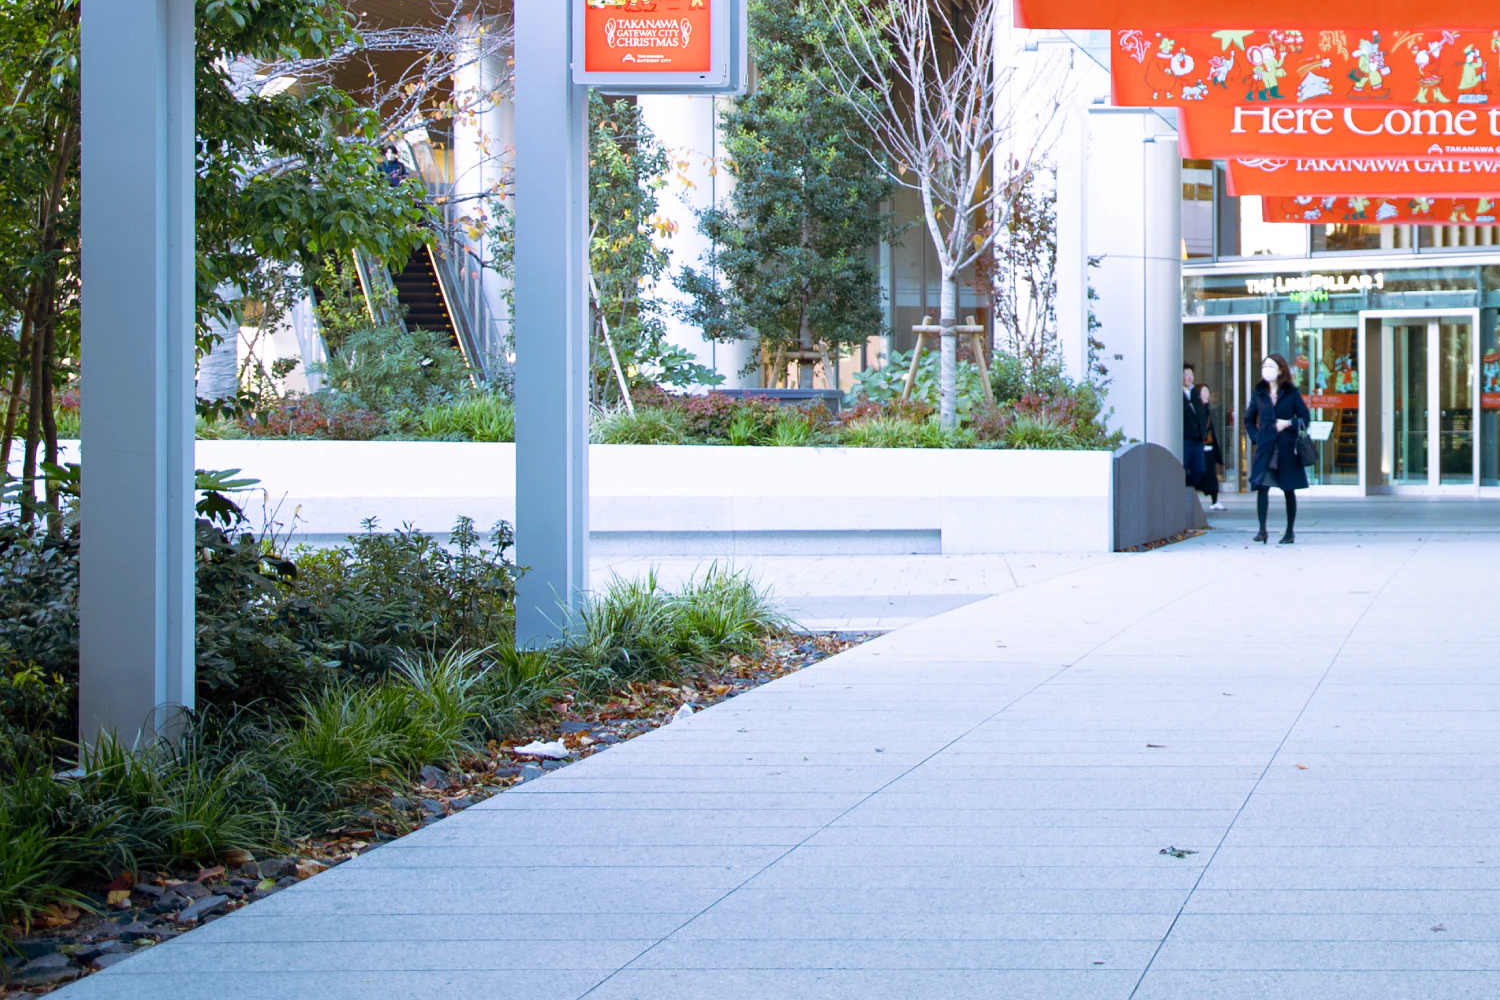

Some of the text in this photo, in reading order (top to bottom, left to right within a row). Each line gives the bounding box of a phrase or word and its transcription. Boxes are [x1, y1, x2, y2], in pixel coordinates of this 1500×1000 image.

[617, 19, 679, 28] TAKANAWA
[617, 36, 678, 46] CHRISTMAS
[1231, 107, 1333, 134] Here
[1344, 108, 1476, 135] Come
[1245, 278, 1275, 294] THE
[1374, 272, 1384, 290] 1
[1289, 291, 1329, 303] NORTH
